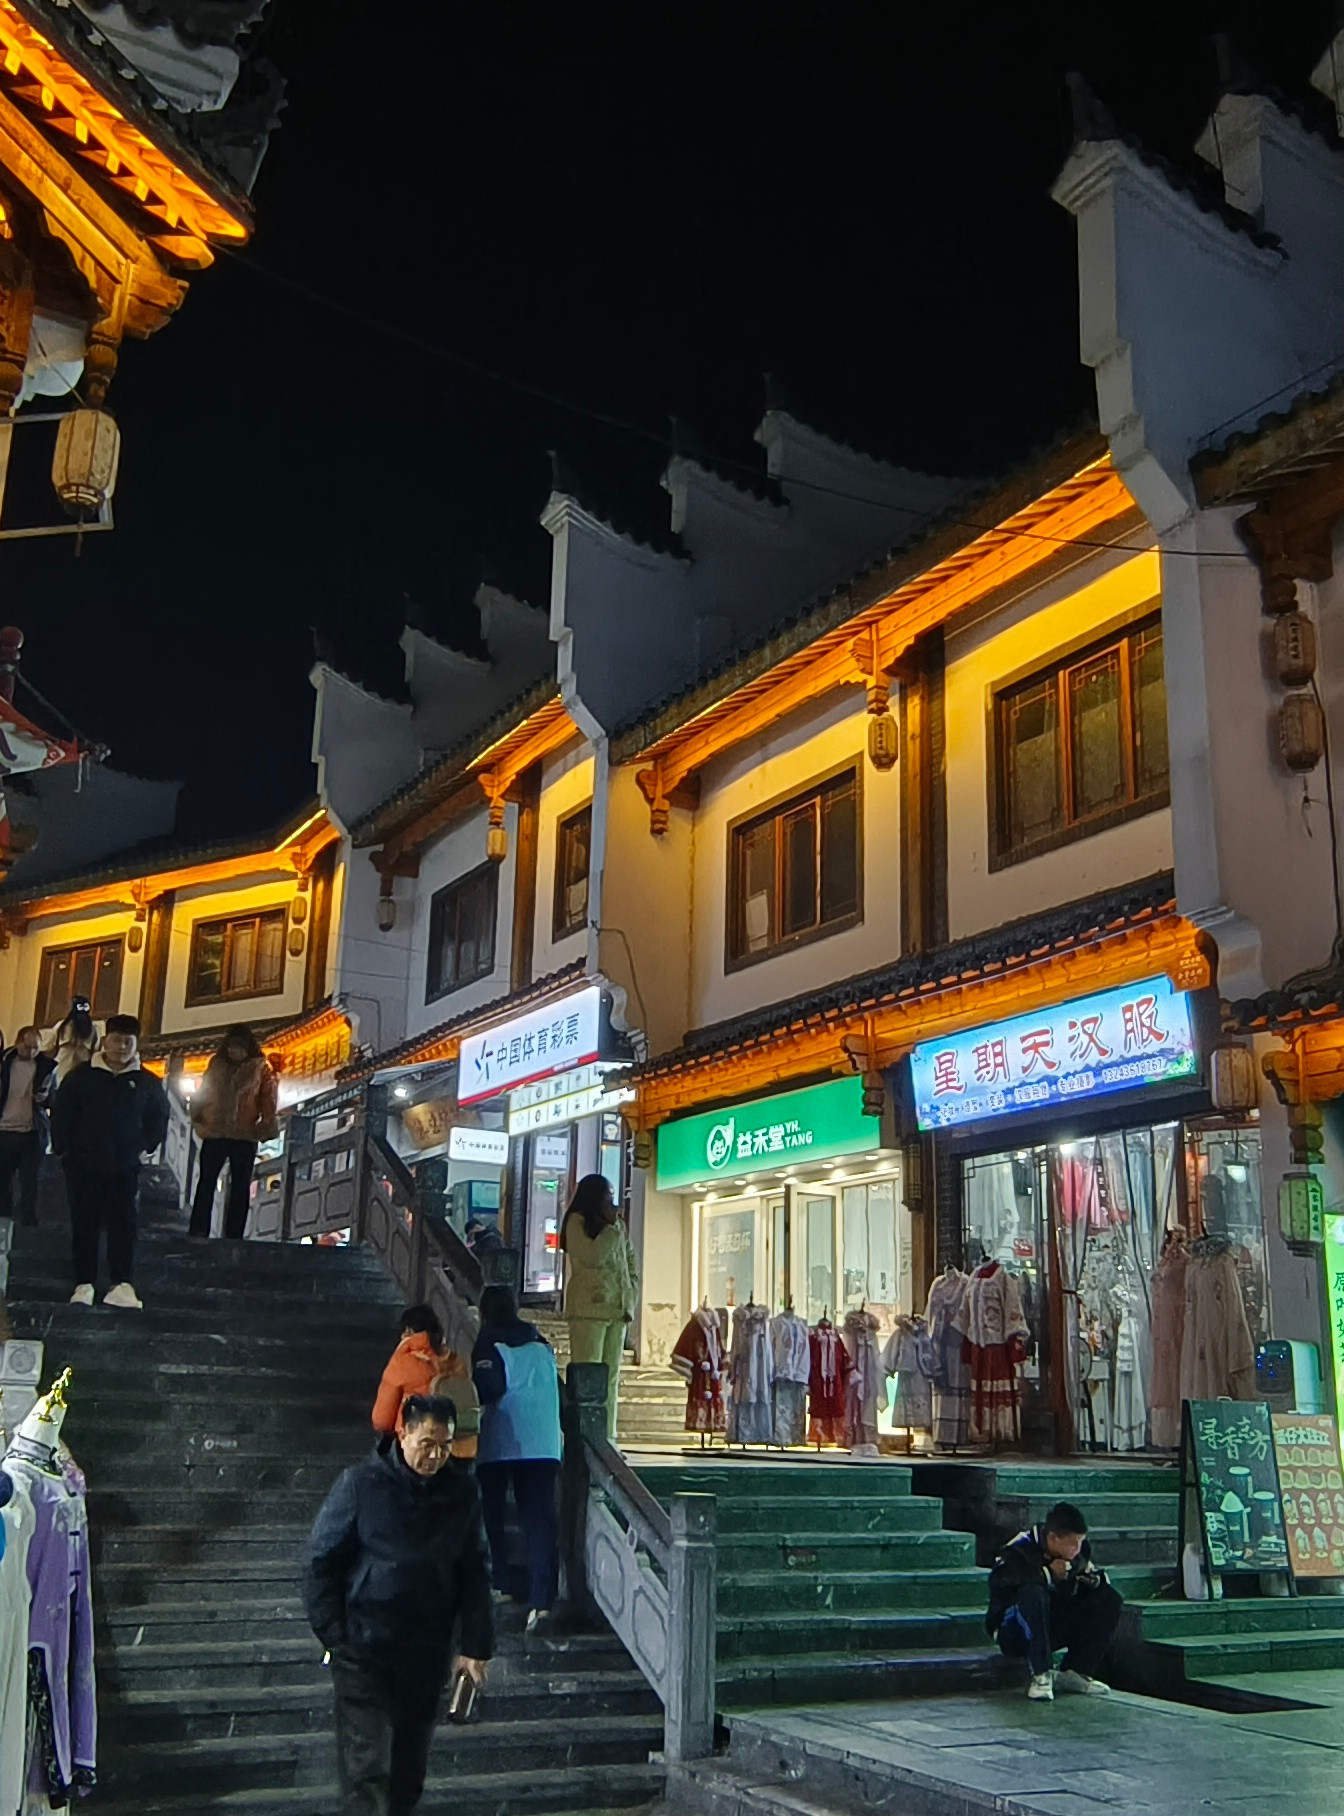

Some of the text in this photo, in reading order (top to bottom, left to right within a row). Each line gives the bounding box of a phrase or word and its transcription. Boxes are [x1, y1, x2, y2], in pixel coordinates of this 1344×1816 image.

[497, 1013, 580, 1070] 中国体育彩票
[932, 995, 1168, 1098] 星期天汉服
[737, 1123, 785, 1158] 益禾堂
[785, 1131, 813, 1148] TANG
